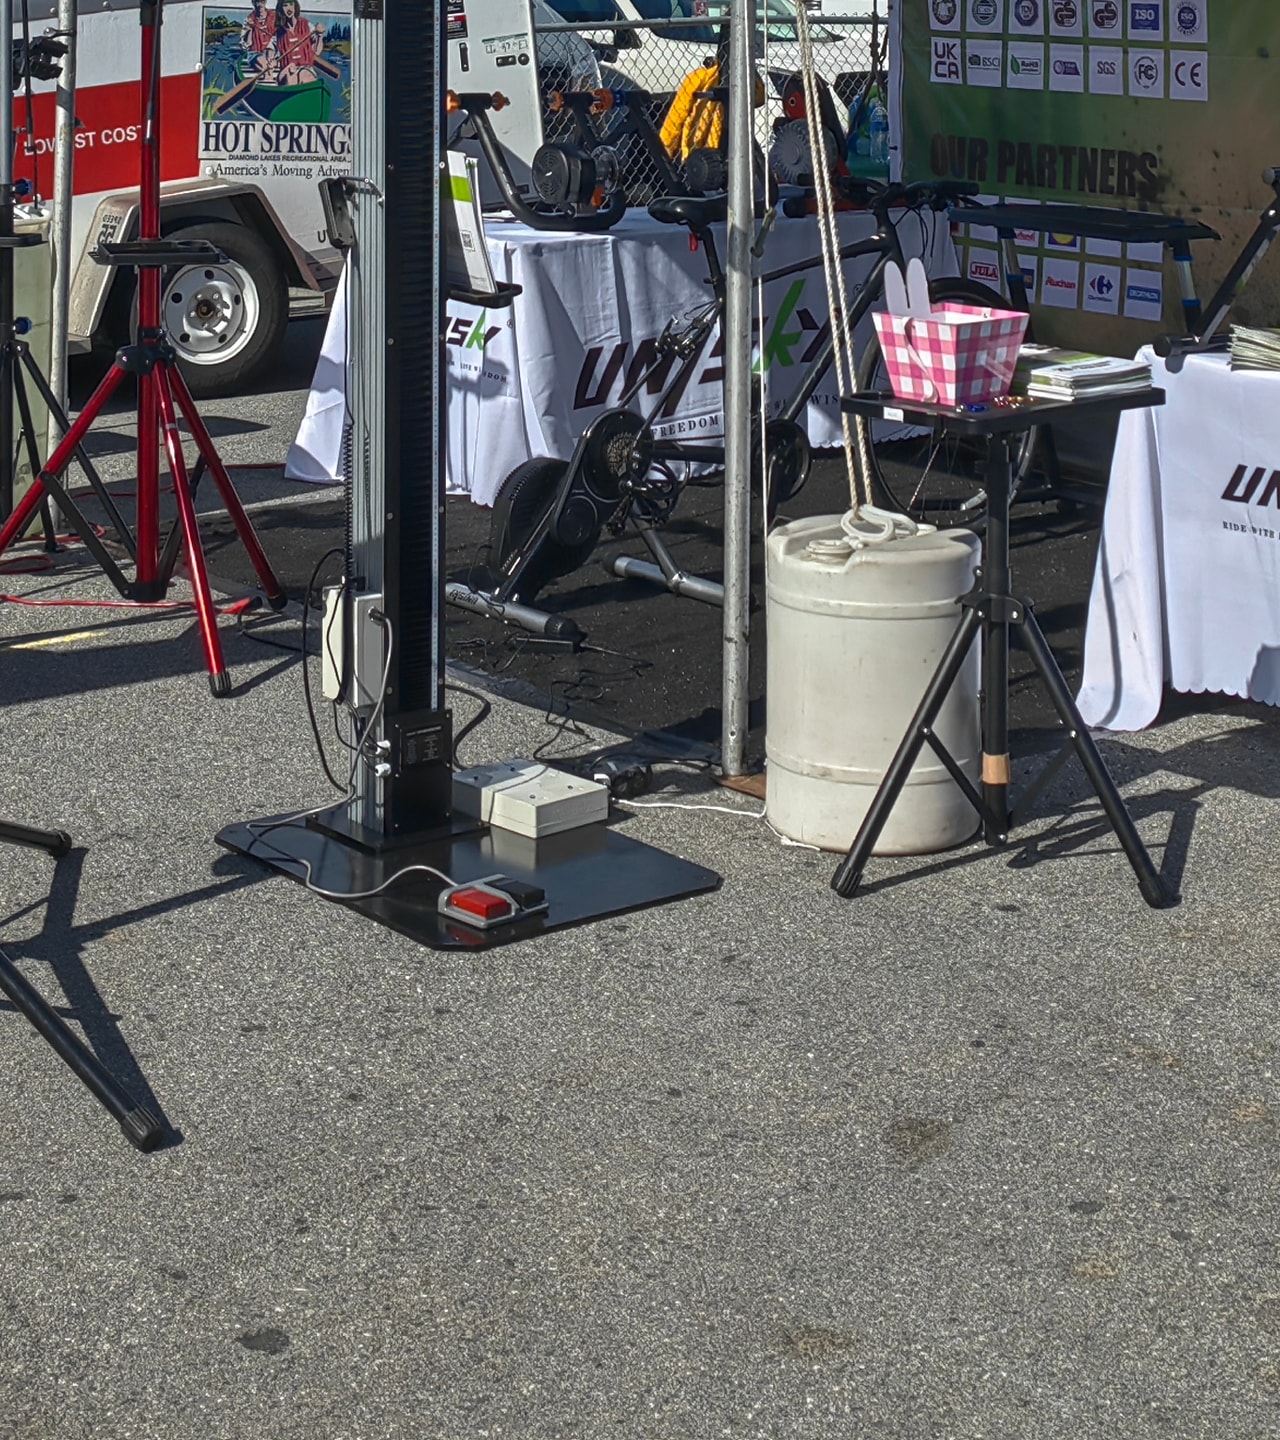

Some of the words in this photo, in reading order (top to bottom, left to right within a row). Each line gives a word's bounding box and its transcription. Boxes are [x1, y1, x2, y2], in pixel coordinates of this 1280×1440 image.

[1135, 9, 1155, 21] ISO
[1180, 12, 1194, 21] ISO
[935, 42, 957, 60] UK
[934, 63, 959, 79] CA
[1097, 61, 1116, 75] SGS
[1174, 62, 1202, 88] CE
[202, 122, 255, 154] HOT
[214, 163, 268, 177] America's
[271, 164, 313, 179] Moving
[930, 132, 989, 182] OUR
[997, 140, 1160, 200] PARTNERS
[972, 264, 998, 278] JULA
[1045, 276, 1076, 290] Auchan
[1223, 521, 1248, 534] RIDE
